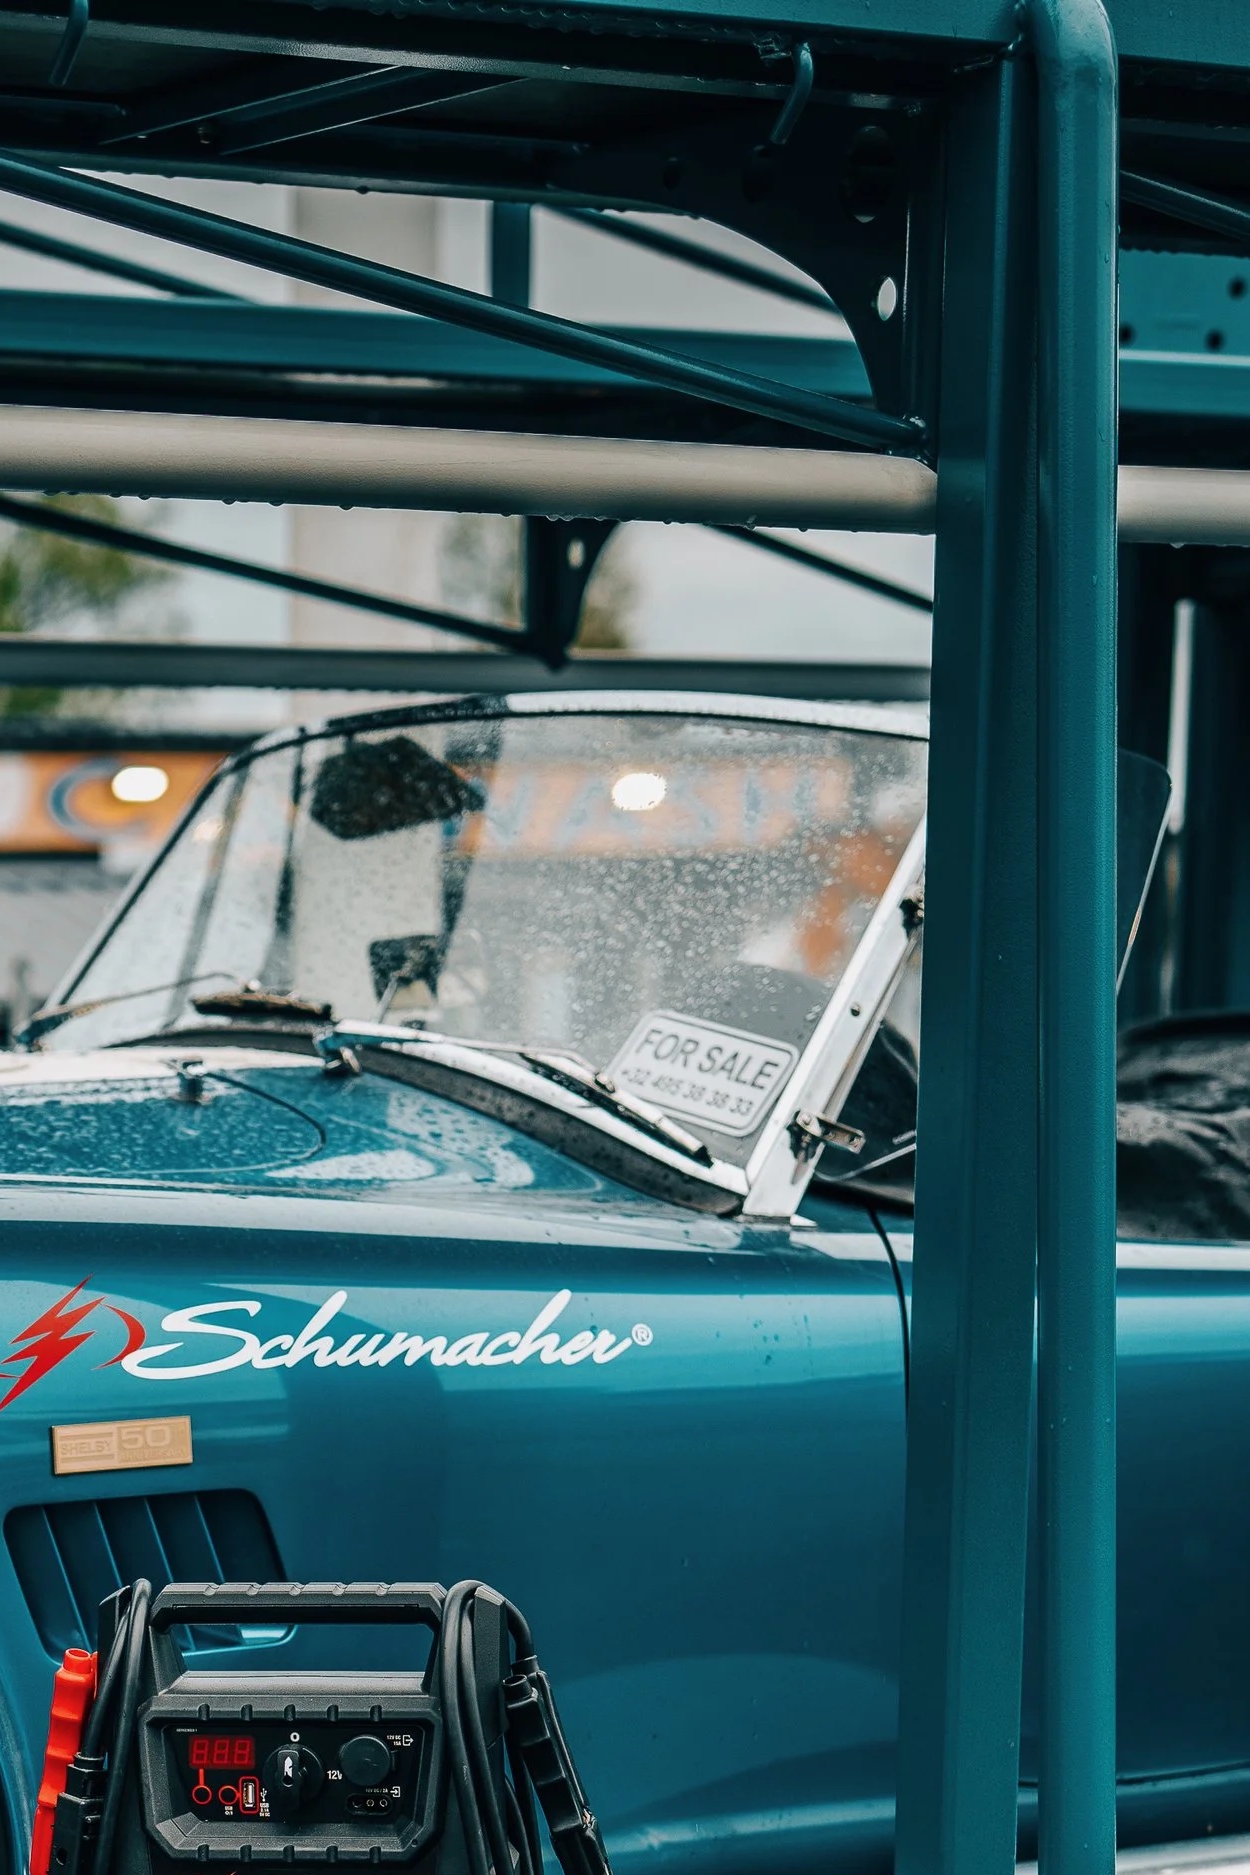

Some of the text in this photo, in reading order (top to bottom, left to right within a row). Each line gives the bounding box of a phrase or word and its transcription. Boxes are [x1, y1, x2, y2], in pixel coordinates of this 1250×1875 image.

[635, 1028, 780, 1091] FOR SALE
[729, 1097, 754, 1117] 33
[60, 1440, 112, 1456] SHELBY
